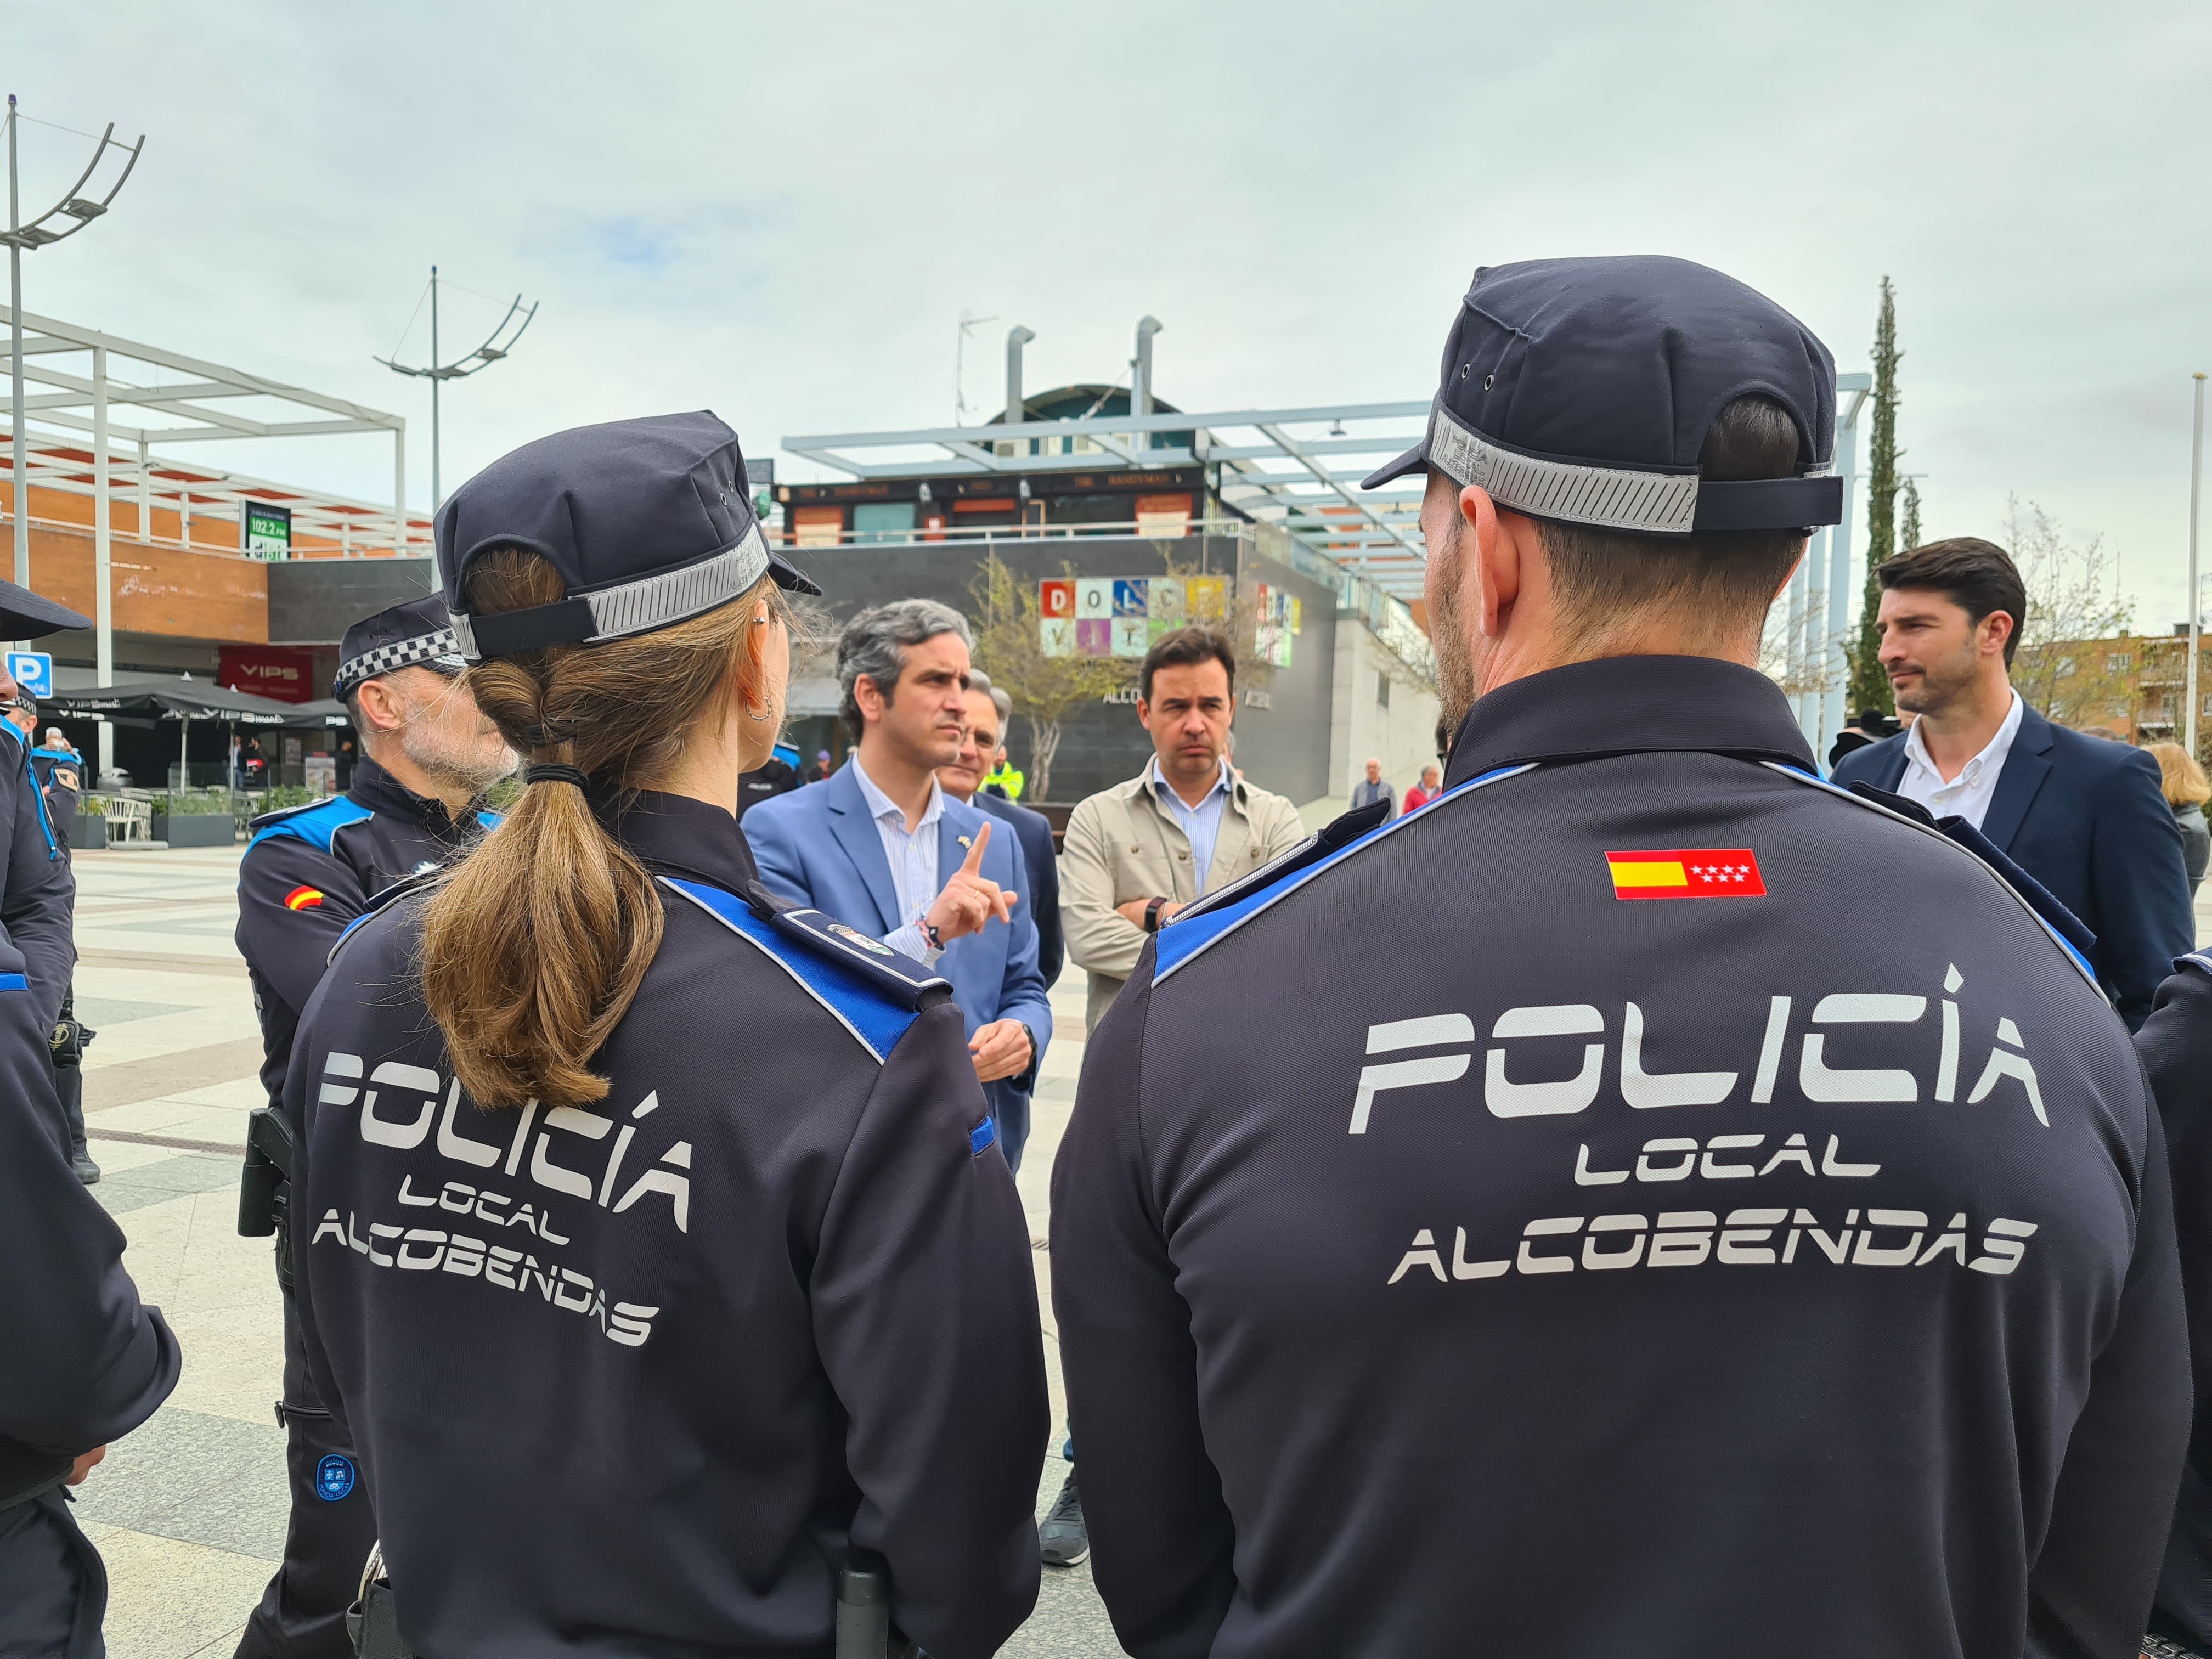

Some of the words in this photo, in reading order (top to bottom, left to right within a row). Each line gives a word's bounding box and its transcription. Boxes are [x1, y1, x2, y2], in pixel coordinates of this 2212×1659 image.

[252, 518, 275, 535] 102.2
[1052, 623, 1139, 646] VIT
[15, 657, 42, 686] P
[240, 664, 298, 680] VIPS
[1348, 962, 2050, 1135] POLICÍA
[315, 1051, 692, 1234] POLICÍA
[1575, 1133, 1881, 1186] LOCAL
[398, 1174, 571, 1246] LOCAL
[1387, 1209, 2039, 1284] ALCOBENDAS
[311, 1209, 660, 1347] ALCOBENDAS
